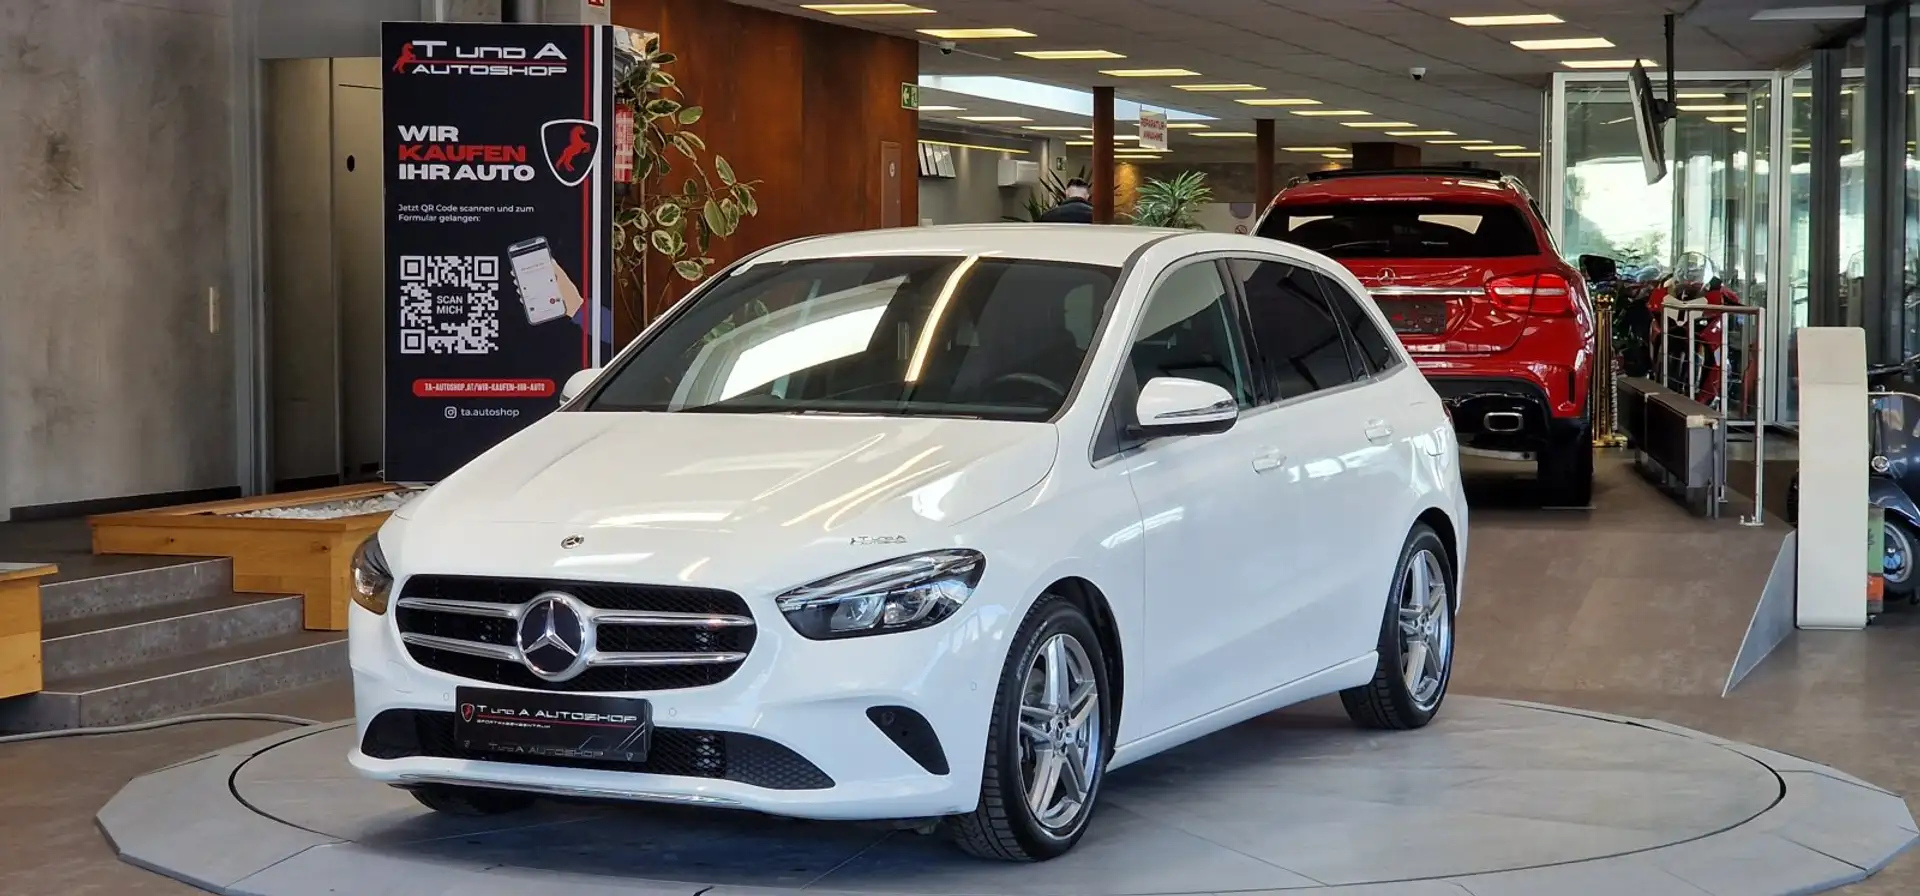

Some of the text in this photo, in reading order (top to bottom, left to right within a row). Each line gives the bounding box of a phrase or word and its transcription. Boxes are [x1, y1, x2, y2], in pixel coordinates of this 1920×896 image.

[412, 40, 447, 58] T
[533, 42, 567, 59] A
[412, 64, 567, 76] AUTOSHOP
[398, 125, 459, 142] WIR
[398, 145, 526, 162] KAUFEN
[398, 164, 535, 181] IHR AUTO
[398, 204, 534, 214] Jetzt QR Code scannen und zum
[398, 213, 481, 224] Formular gelangen:
[436, 295, 463, 304] SCAN
[436, 305, 463, 315] MICH
[460, 407, 520, 418] ta.autoshop
[477, 705, 487, 713] T
[519, 709, 530, 717] A
[535, 709, 638, 723] AUTOSHOP
[528, 746, 604, 759] AUTOSHOP
